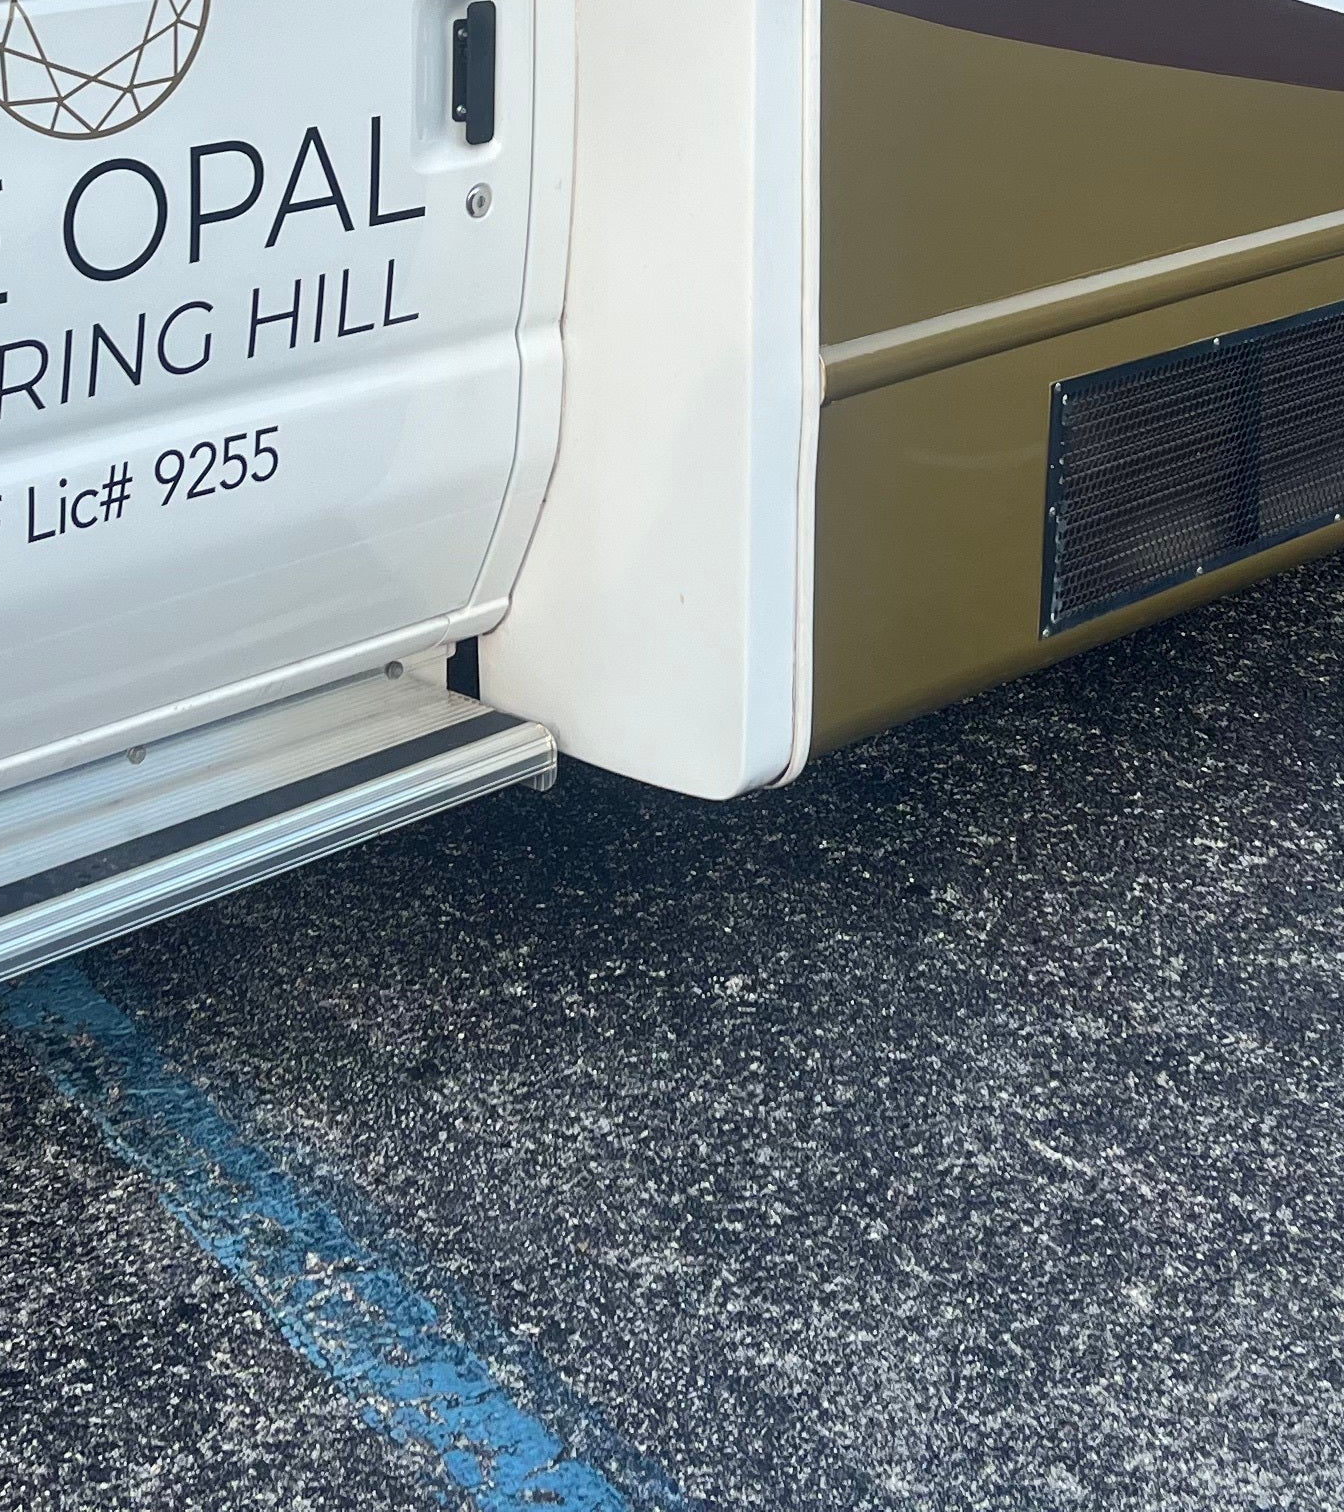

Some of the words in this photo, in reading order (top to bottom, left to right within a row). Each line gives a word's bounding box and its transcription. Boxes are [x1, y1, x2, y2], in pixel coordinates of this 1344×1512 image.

[63, 115, 426, 282] OPAL
[247, 259, 419, 358] HILL
[26, 461, 133, 545] Lic#
[154, 425, 280, 506] 9255
